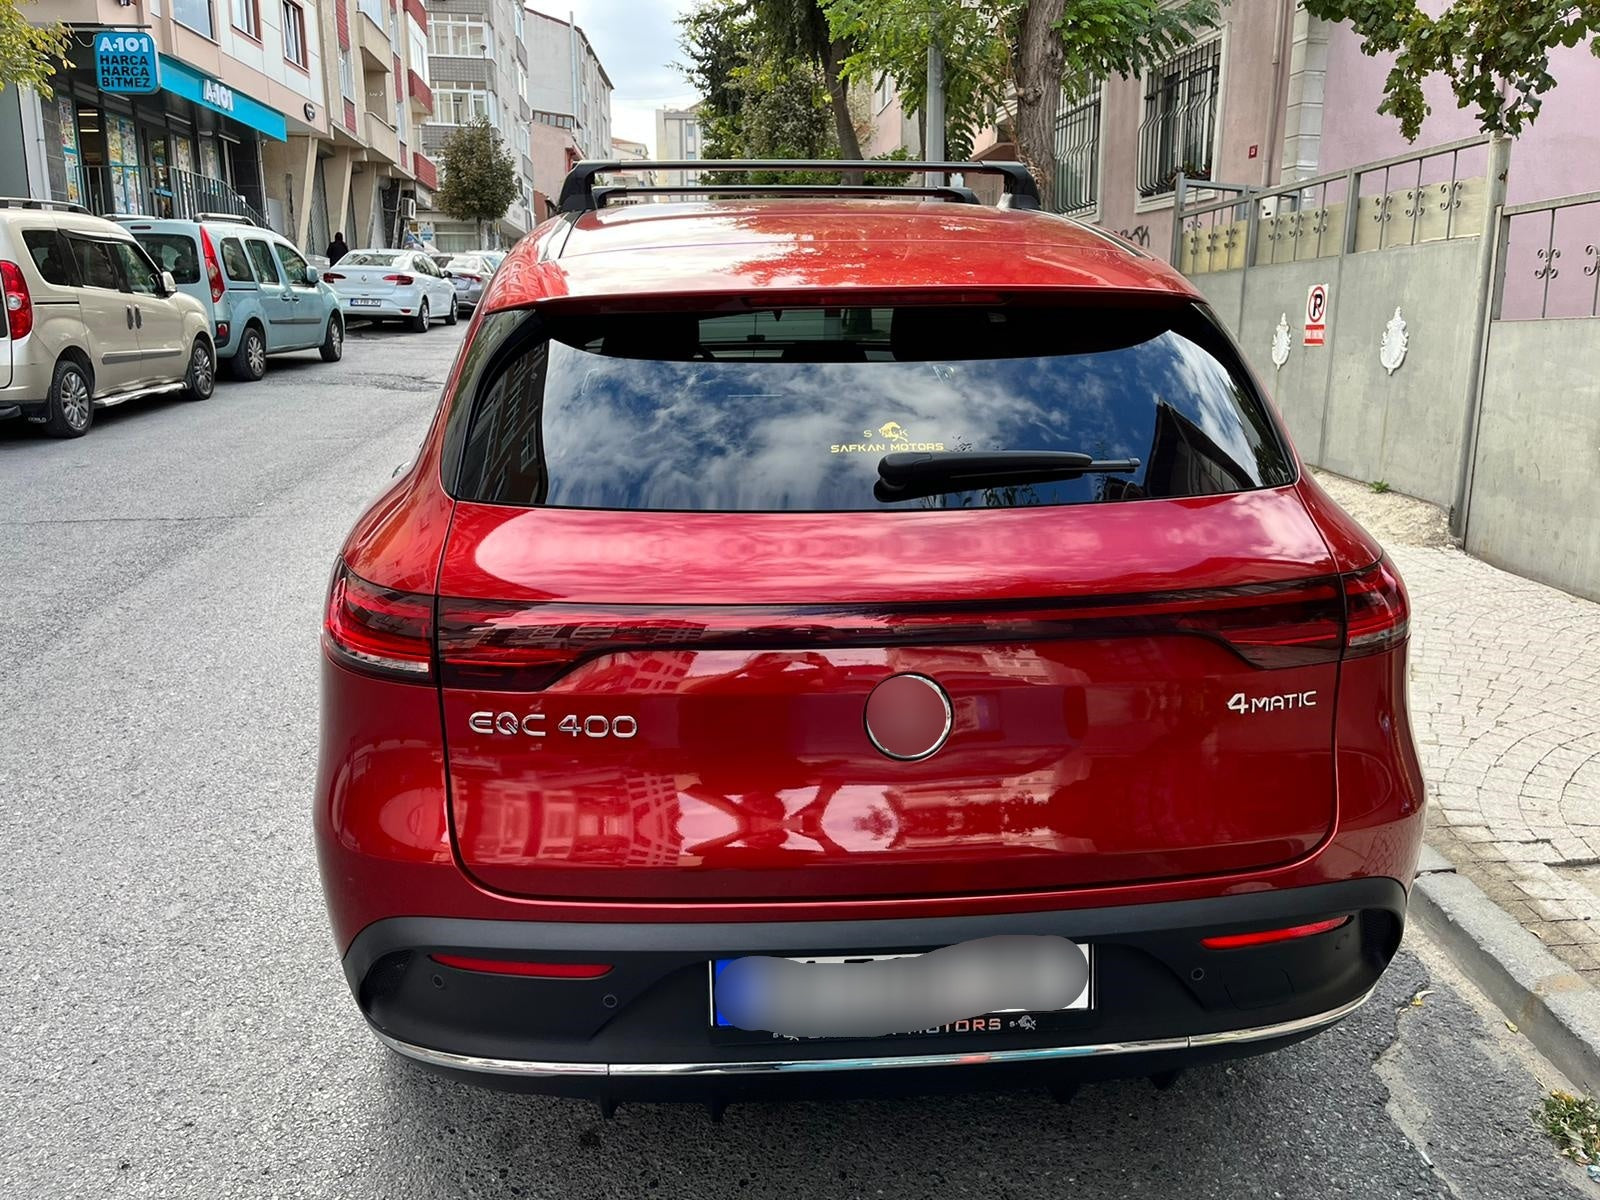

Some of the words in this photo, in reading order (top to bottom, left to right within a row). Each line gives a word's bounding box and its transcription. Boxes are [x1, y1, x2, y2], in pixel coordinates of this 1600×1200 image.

[100, 54, 148, 66] HARCA
[101, 65, 150, 77] HARCA
[830, 444, 886, 453] SAFKAN
[890, 442, 945, 452] MOTORS
[468, 711, 546, 736] EQC
[558, 714, 638, 738] 400
